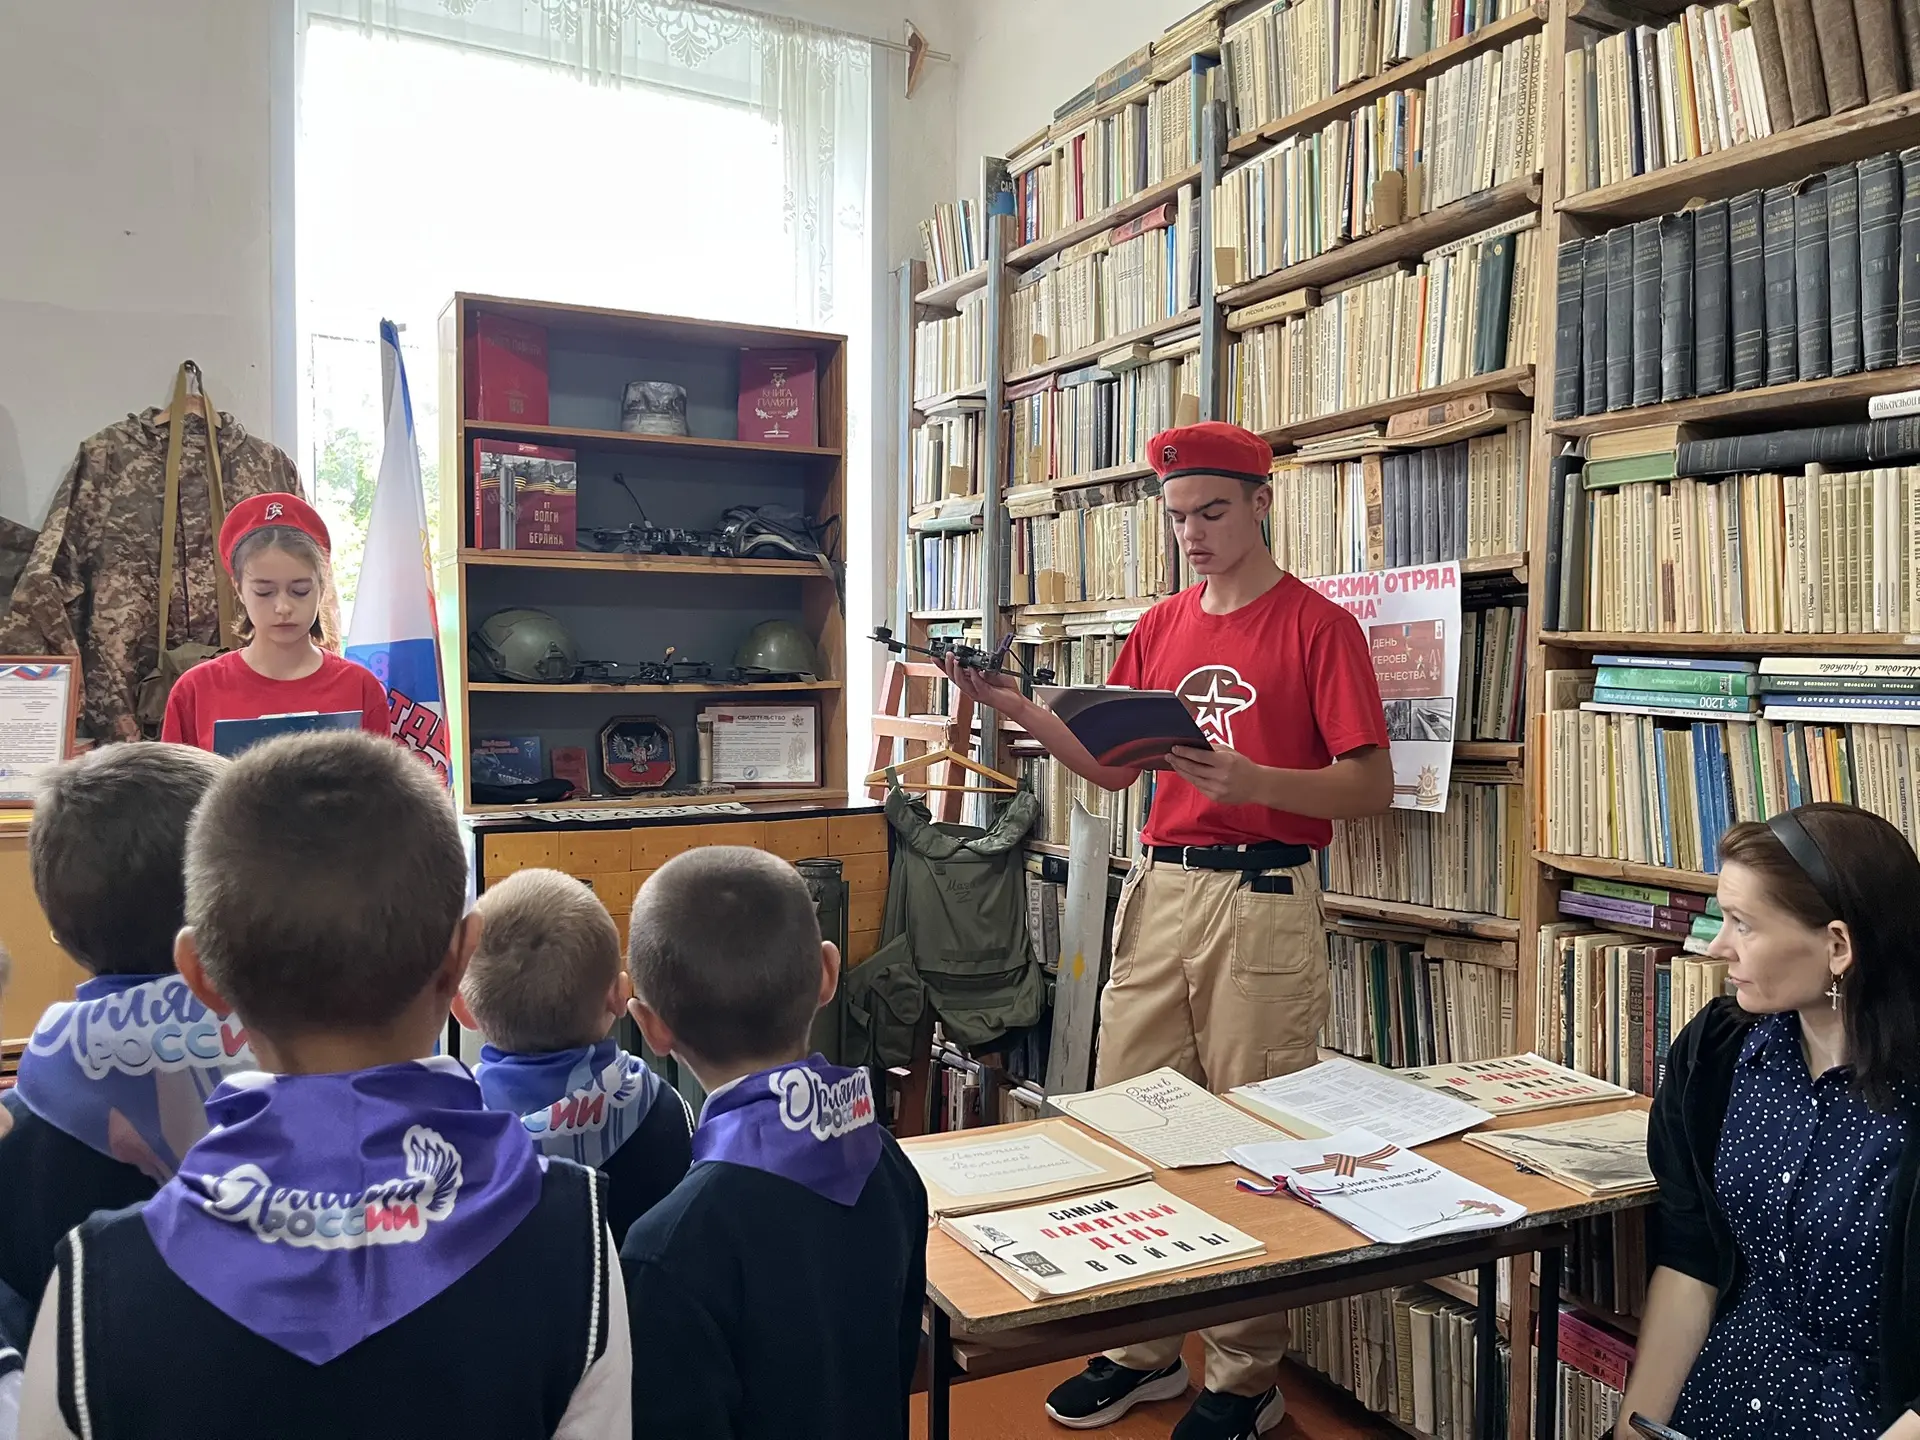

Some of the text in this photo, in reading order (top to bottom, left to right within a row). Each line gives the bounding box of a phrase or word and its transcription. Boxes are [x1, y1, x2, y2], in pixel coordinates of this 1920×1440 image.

[758, 398, 798, 407] ПАМЯТИ
[1874, 397, 1916, 411] ПОЧЕМУЧКИ
[534, 510, 559, 523] ВОЛГИ
[529, 533, 564, 545] БЕРЛИНА
[1305, 567, 1456, 599] ЙСКИЙ ОТРЯД
[1372, 637, 1398, 650] ДЕНЬ
[1372, 654, 1408, 666] ГЕРОЕВ
[1820, 661, 1868, 675] Саратова
[1700, 697, 1724, 709] 1200
[1838, 698, 1899, 706] САРАТОВСКОЙ
[1458, 1059, 1532, 1072] НИЧТО
[1446, 1068, 1550, 1086] НЕ ЗАБЫТО
[1504, 1076, 1579, 1090] НИКТО
[1494, 1095, 1518, 1104] НЕ
[1048, 1198, 1120, 1222] САМЫЙ
[262, 1203, 421, 1238] РОССИИ
[1040, 1203, 1179, 1240] ПАМЯТНЫЙ
[1089, 1226, 1170, 1251] ДЕНЬ
[1084, 1232, 1230, 1272] ВОЙНЫ
[1032, 1262, 1056, 1275] 30
